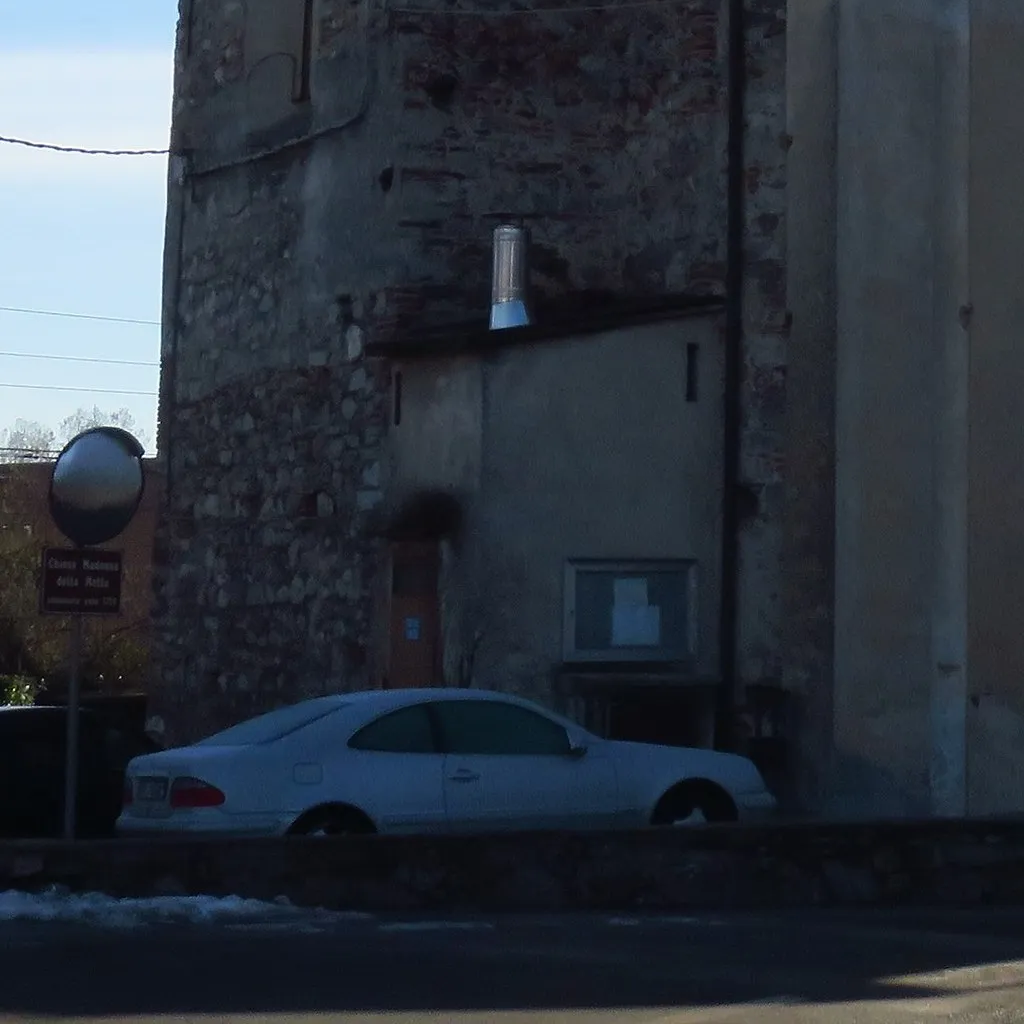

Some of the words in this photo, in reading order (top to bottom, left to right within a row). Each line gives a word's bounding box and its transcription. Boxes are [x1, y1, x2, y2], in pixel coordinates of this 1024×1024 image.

[48, 558, 77, 569] Chiesa
[83, 559, 119, 571] Madonna
[56, 576, 79, 587] della
